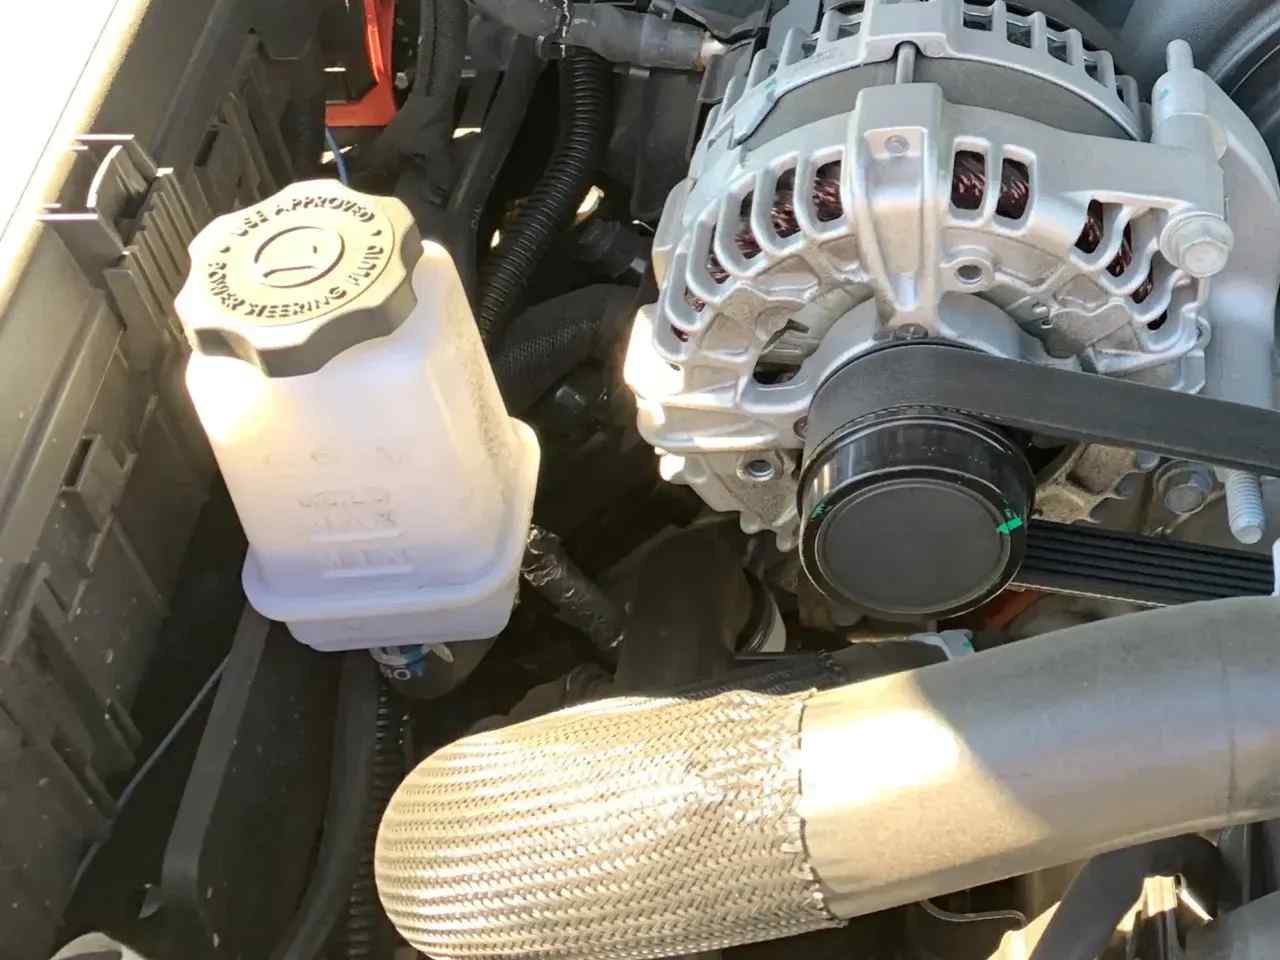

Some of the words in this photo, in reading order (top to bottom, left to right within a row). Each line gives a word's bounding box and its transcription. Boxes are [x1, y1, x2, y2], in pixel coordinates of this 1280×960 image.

[231, 210, 270, 238] USE
[273, 195, 376, 224] APPROVED
[207, 262, 246, 311] POWER
[244, 286, 347, 318] STEERING
[348, 245, 384, 286] FLUID
